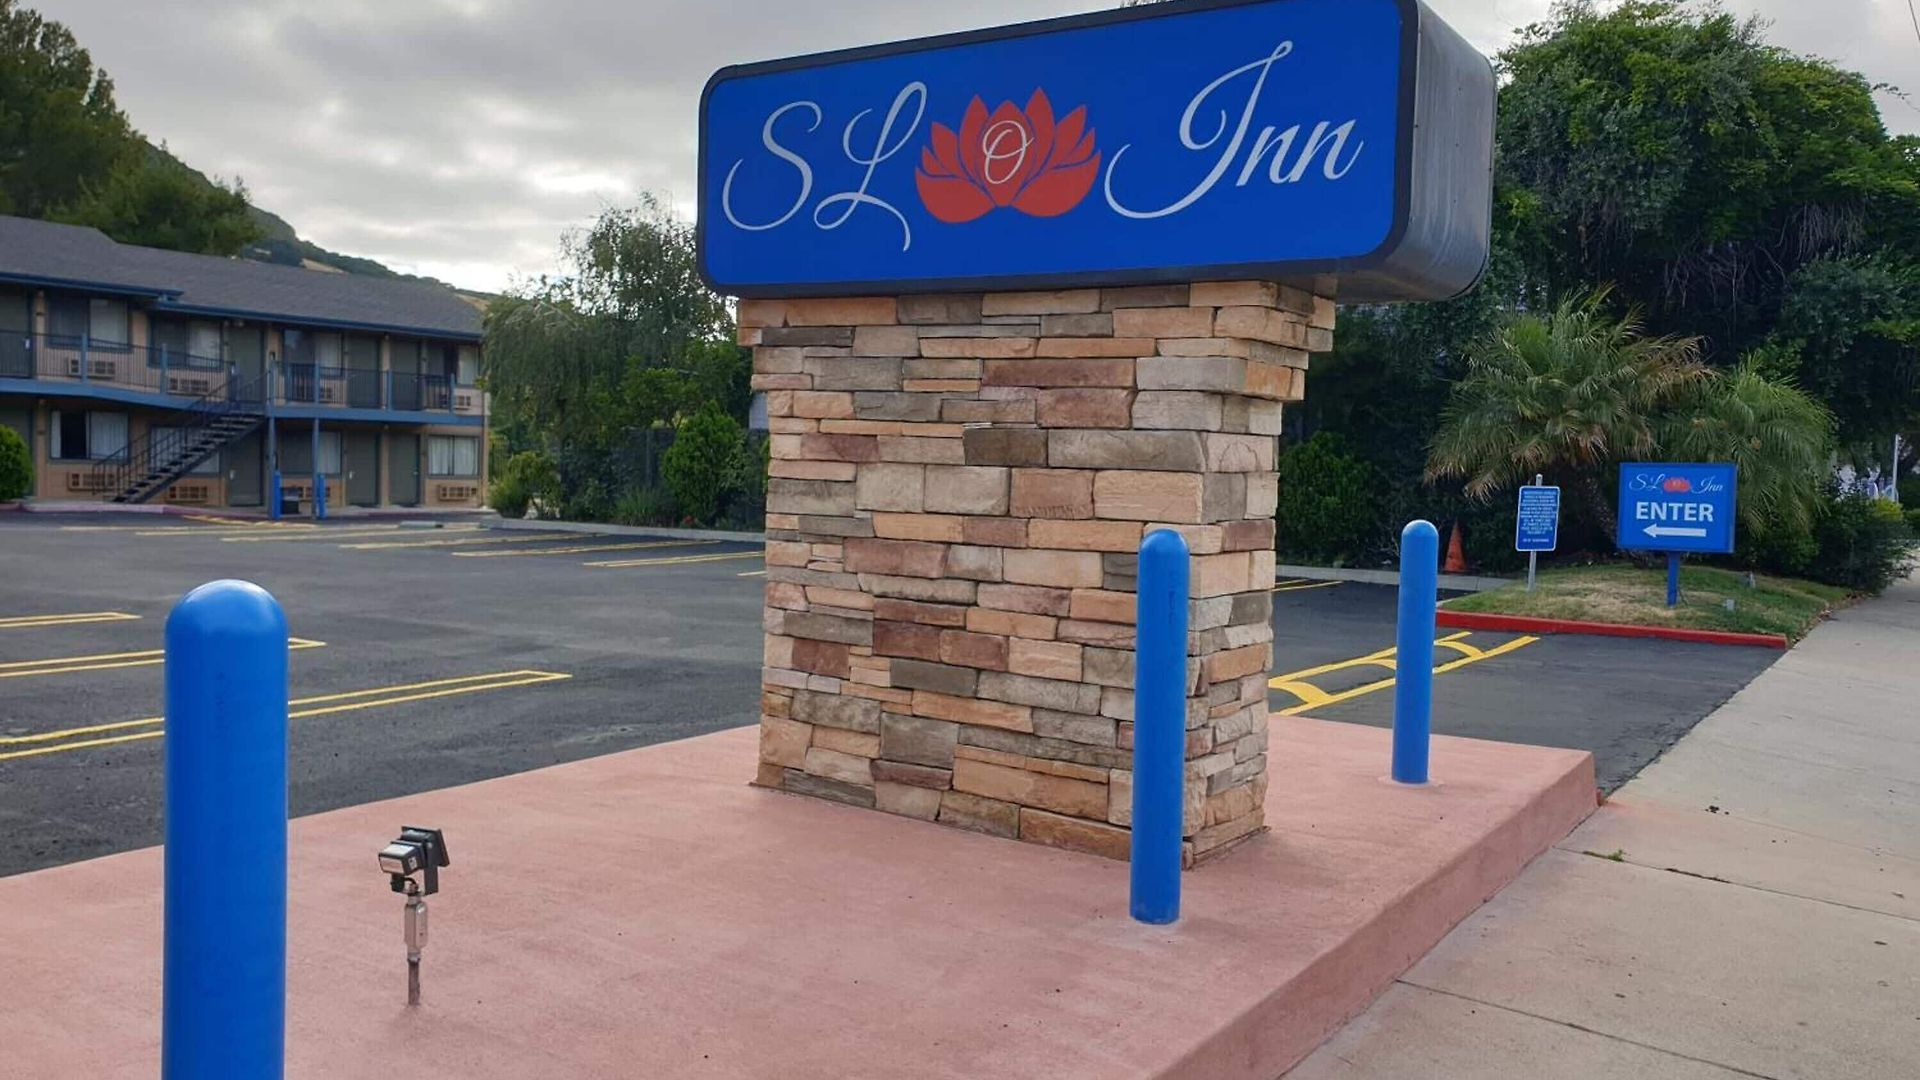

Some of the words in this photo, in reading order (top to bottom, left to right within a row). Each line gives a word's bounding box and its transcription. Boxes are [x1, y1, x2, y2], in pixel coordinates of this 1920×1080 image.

[1104, 40, 1364, 219] Inn
[1690, 475, 1723, 494] Inn
[1635, 501, 1714, 522] ENTER
